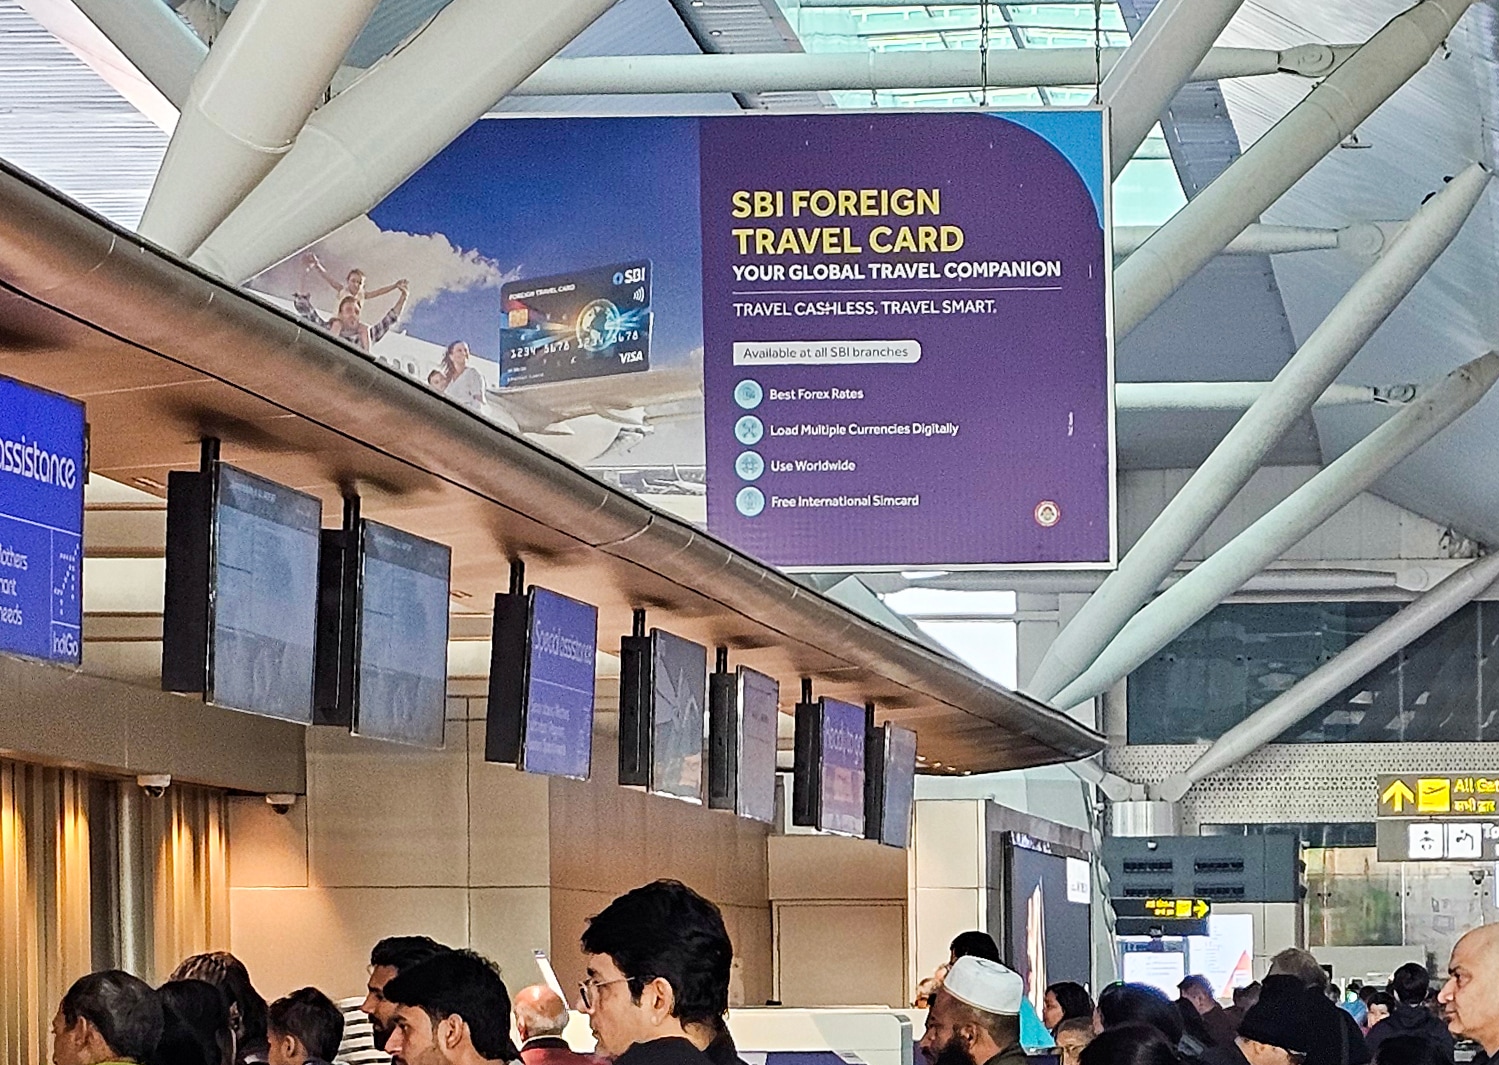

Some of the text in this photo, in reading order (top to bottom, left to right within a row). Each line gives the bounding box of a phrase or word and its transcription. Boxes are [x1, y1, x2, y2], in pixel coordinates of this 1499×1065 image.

[732, 188, 940, 218] SBI FOREIGN
[732, 225, 964, 255] TRAVEL CARD
[732, 261, 1061, 282] YOUR GLOBAL TRAVEL COMPANION
[733, 299, 997, 317] TRAVEL CASHLESS. TRAVEL SMART.
[618, 350, 644, 364] VISA
[743, 345, 908, 359] Available at all SBI branches
[769, 386, 864, 400] Best Forex Rates
[770, 421, 959, 437] Load Multiple Currencies Digitally
[771, 458, 856, 472] Use Worldwide
[771, 494, 919, 508] Free International Simcard
[53, 629, 79, 657] IndiGo
[1453, 777, 1474, 793] All
